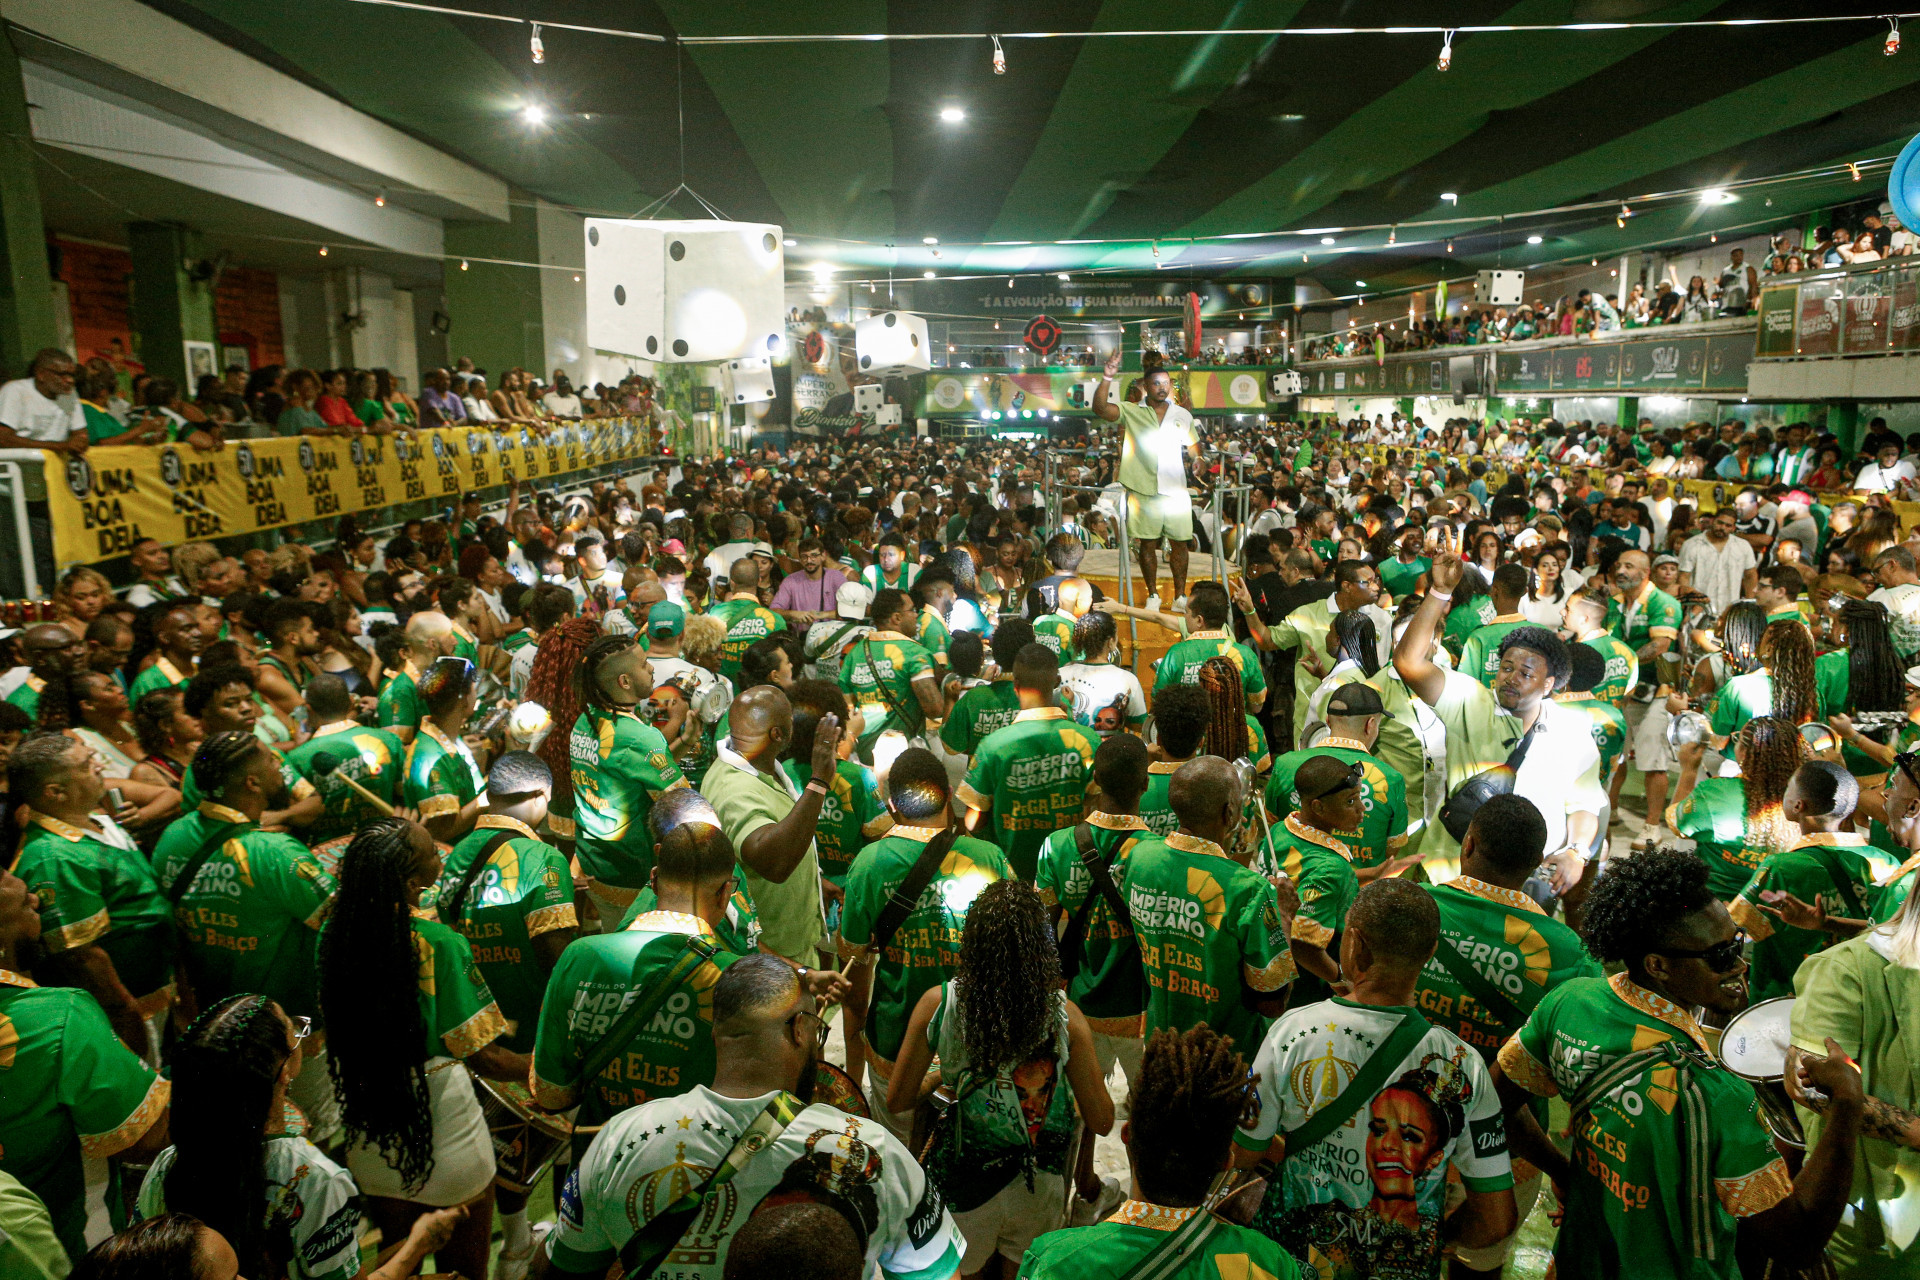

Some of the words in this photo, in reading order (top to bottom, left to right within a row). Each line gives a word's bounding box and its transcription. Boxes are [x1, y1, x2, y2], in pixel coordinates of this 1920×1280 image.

[1004, 293, 1063, 310] EVOLUÇÃO
[1065, 296, 1083, 307] EM
[1084, 296, 1109, 307] SUA
[1111, 293, 1162, 307] LEGÍTIMA
[254, 457, 285, 479] UMA
[314, 452, 338, 472] UMA
[93, 468, 139, 497] UMA
[182, 462, 219, 487] UMA
[307, 473, 330, 496] BOA
[357, 467, 378, 488] BOA
[246, 480, 276, 505] BOA
[82, 498, 125, 530] BOA
[728, 625, 767, 636] RRANO
[736, 617, 765, 628] ÉRIO
[978, 708, 1021, 723] IMPÉR
[570, 745, 599, 766] ERRANO
[1011, 752, 1080, 776] IMPÉRIO
[1006, 765, 1082, 788] SERRANO
[1012, 799, 1049, 816] PEGA
[1050, 793, 1081, 810] ELES
[1055, 812, 1081, 829] BRA
[1140, 812, 1179, 828] IMPÉ
[1130, 887, 1200, 919] IMPÉRIO
[197, 907, 240, 928] ELES
[1129, 900, 1205, 938] SERRANO
[206, 928, 258, 955] BRAÇO
[1443, 935, 1519, 971] PÉRIO
[914, 954, 936, 967] SEM
[937, 946, 962, 966] BRA
[1163, 943, 1204, 972] ELES
[578, 980, 610, 990] BATERIA
[1149, 973, 1164, 989] EM
[1167, 969, 1220, 1004] BRAÇO
[573, 983, 690, 1014] IMPÉO
[567, 1008, 696, 1040] SERNO
[1556, 1028, 1577, 1044] BATERIA
[1577, 1039, 1588, 1047] DO
[626, 1051, 680, 1087] ELES
[1295, 1150, 1366, 1187] ERRANO
[1586, 1147, 1650, 1212] BRAÇO
